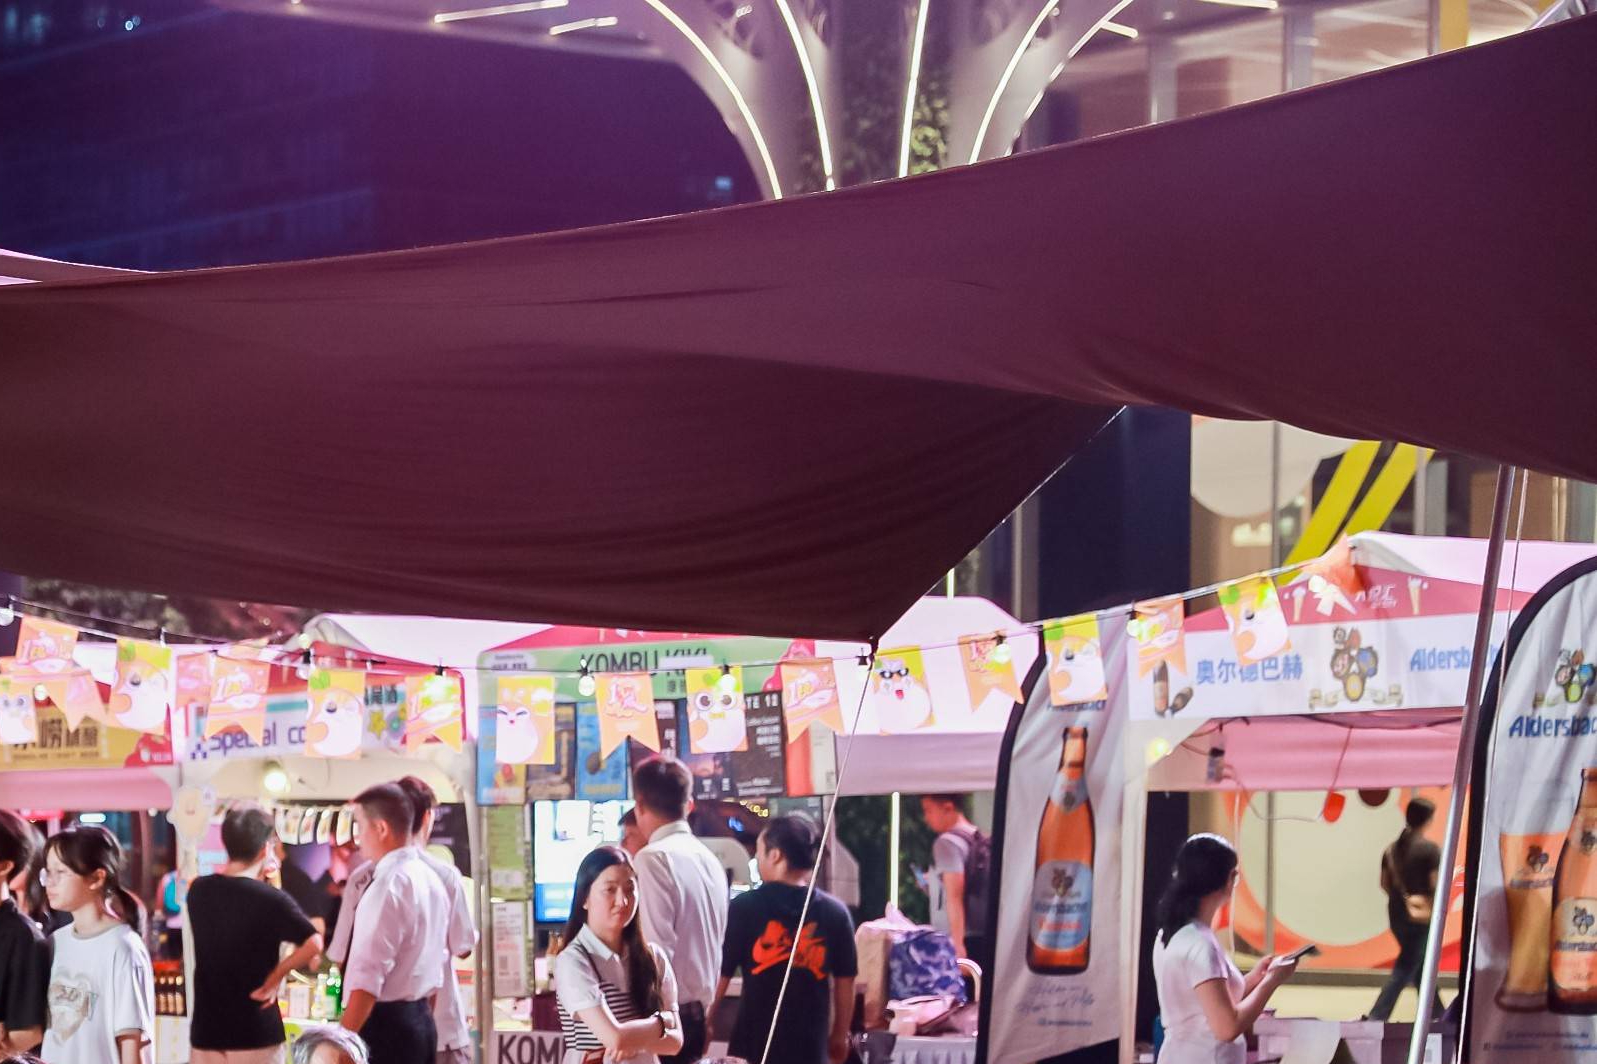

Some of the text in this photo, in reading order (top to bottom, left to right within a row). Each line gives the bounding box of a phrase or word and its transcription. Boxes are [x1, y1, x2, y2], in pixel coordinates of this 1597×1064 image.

[1196, 654, 1303, 685] 奥尔德巴赫
[209, 721, 277, 757] Specal
